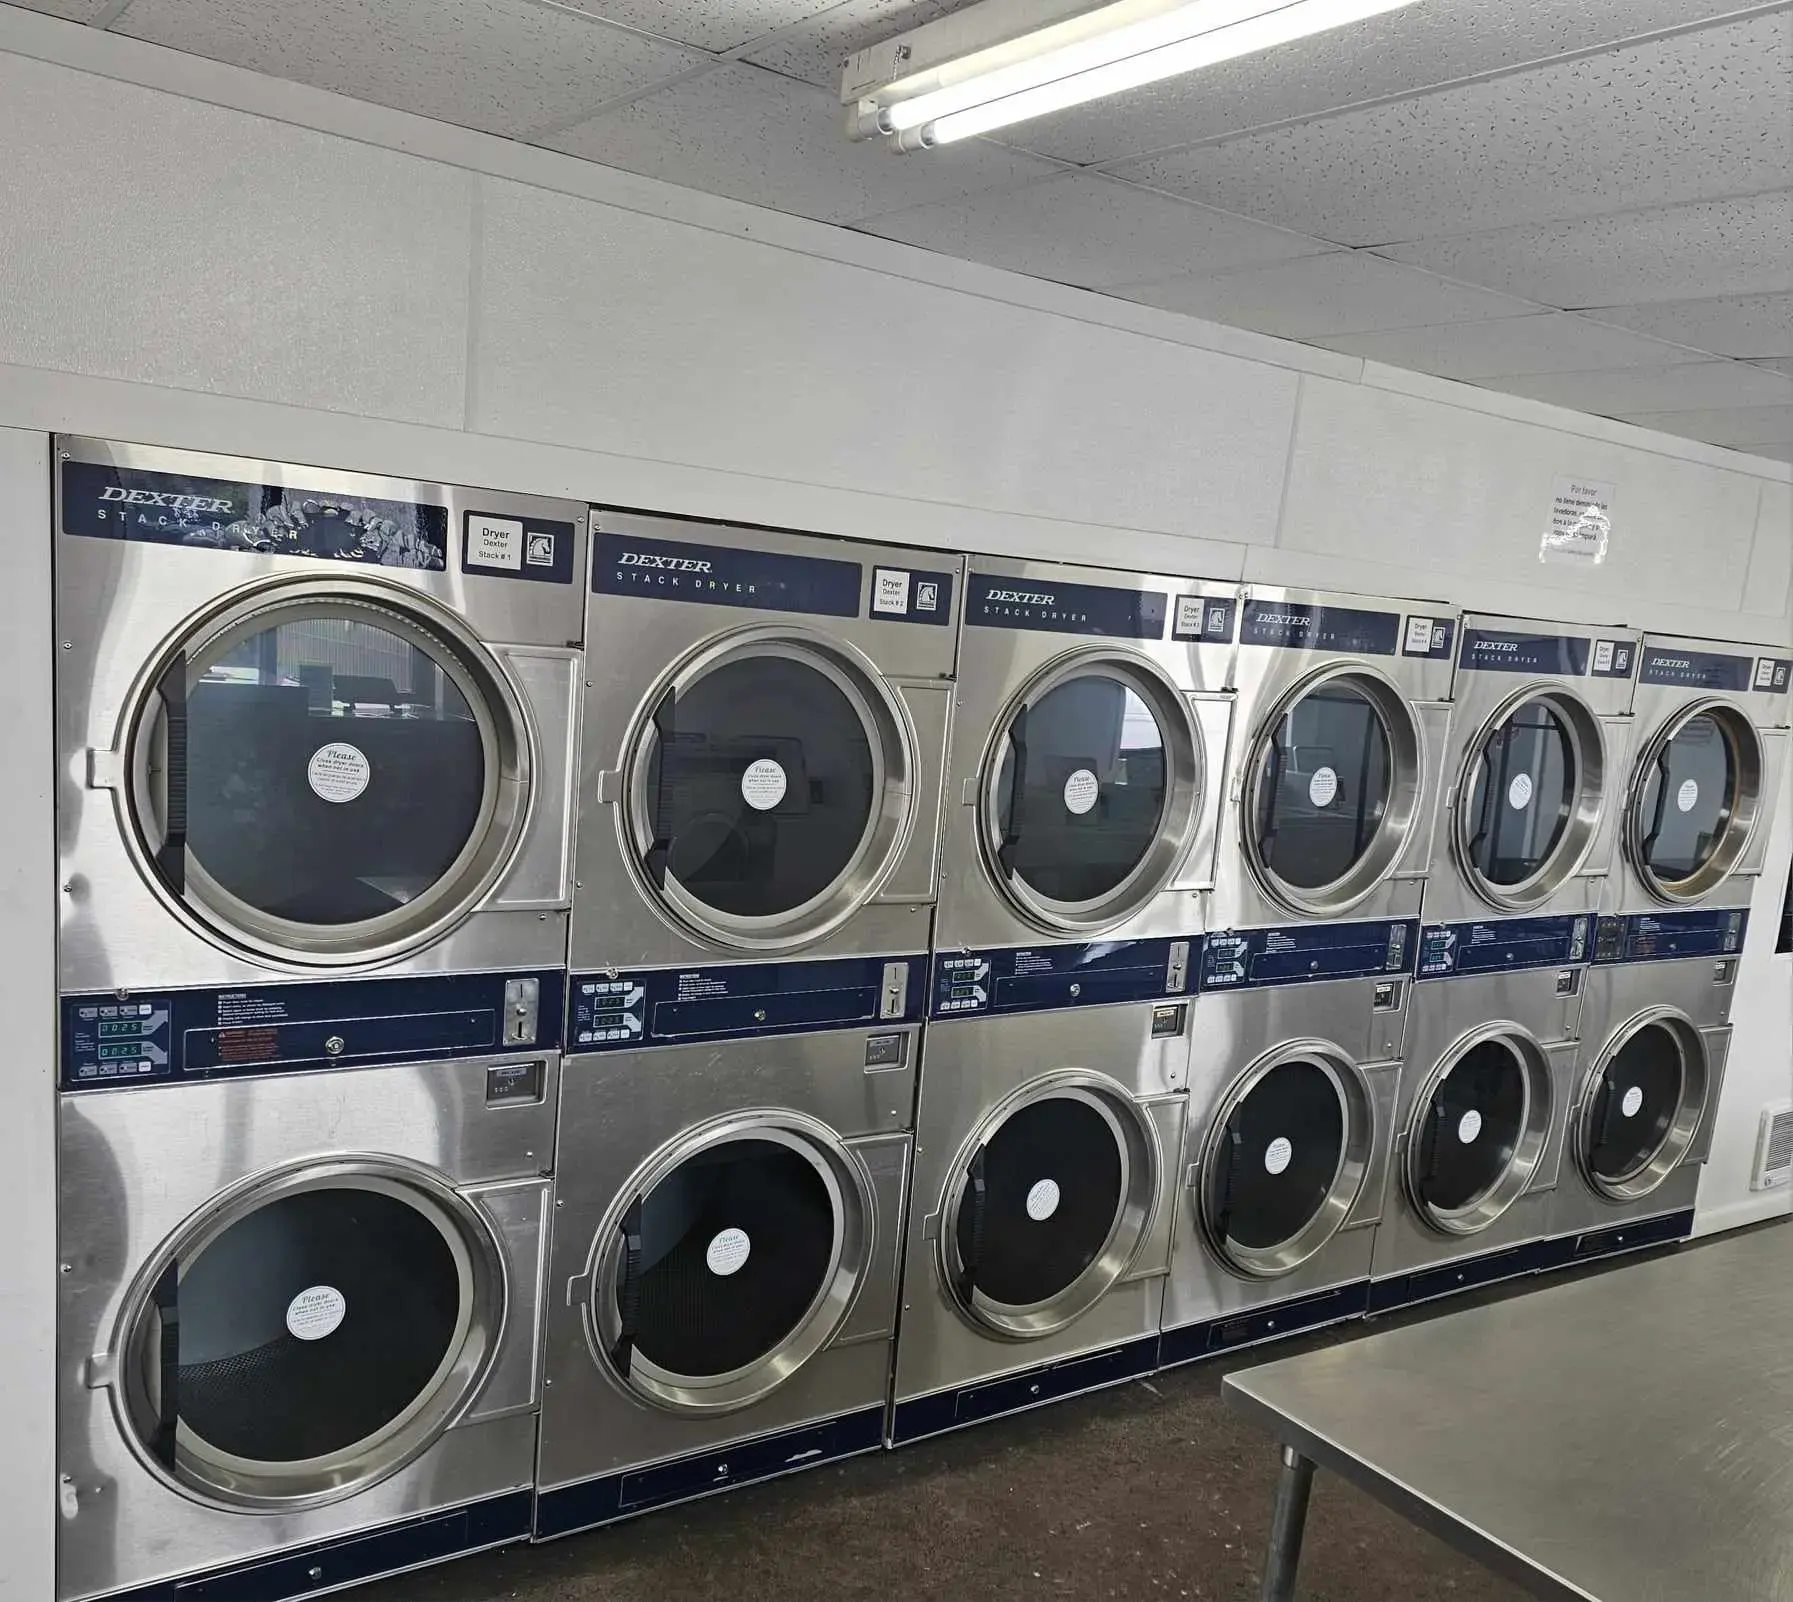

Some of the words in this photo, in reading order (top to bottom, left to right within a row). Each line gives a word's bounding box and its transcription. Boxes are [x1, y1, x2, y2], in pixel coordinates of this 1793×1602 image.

[98, 486, 234, 514] DEXTER
[98, 509, 188, 528] STACK
[212, 520, 298, 540] DRYER
[482, 528, 510, 540] Dryer
[484, 539, 508, 548] Dexter
[478, 551, 498, 559] Stack
[616, 552, 711, 574] DEXTER
[616, 572, 680, 586] STACK
[695, 578, 756, 594] DRYER
[882, 578, 902, 590] Dryer
[985, 589, 1055, 606] DEXTER
[984, 605, 1030, 617] STACK
[1042, 610, 1087, 622] DRYER
[1184, 605, 1200, 614] Dryer
[1255, 613, 1310, 626] DEXTER
[1473, 640, 1518, 652] DEXTER
[1651, 658, 1690, 668] DEXTER
[328, 750, 356, 760] Please
